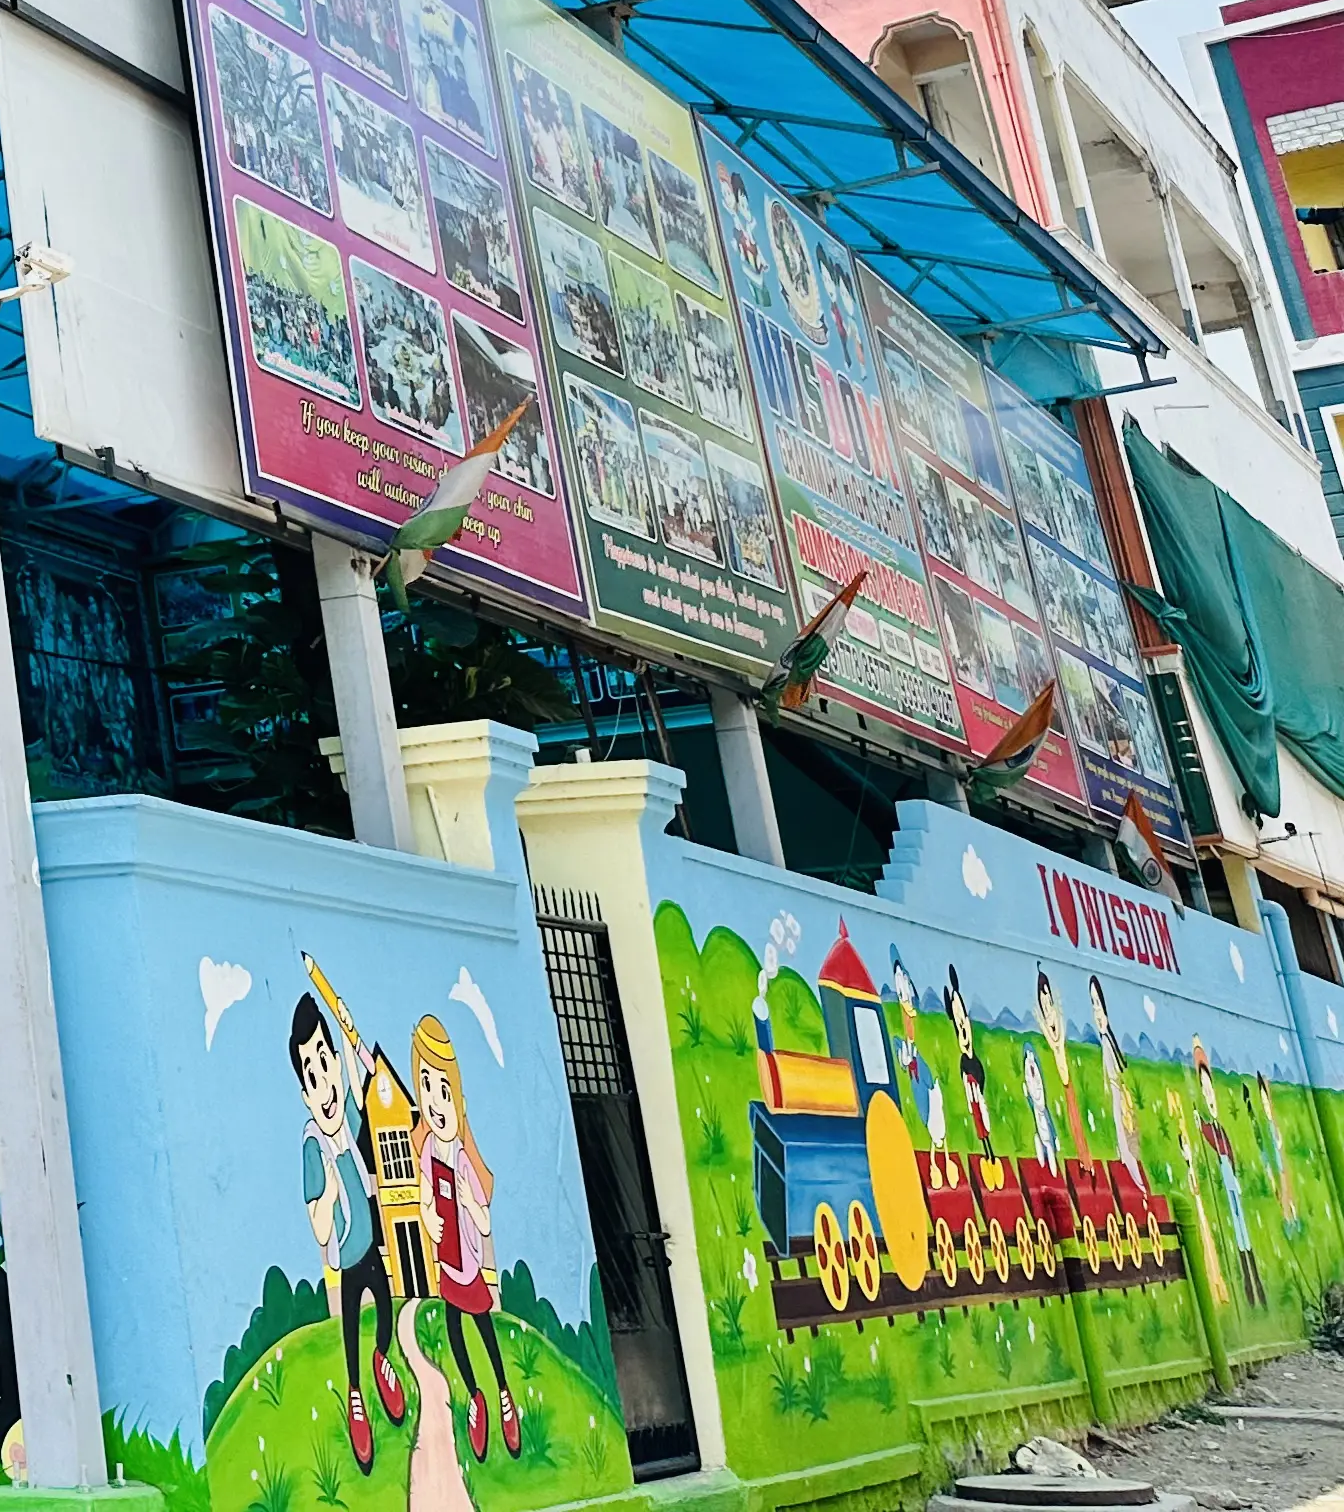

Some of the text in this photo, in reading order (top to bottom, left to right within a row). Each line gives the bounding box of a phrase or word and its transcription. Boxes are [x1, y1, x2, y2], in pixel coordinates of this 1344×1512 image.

[740, 297, 903, 498] WISDOM
[299, 400, 316, 434] If
[316, 416, 342, 439] you
[343, 417, 370, 457] keep
[372, 441, 401, 464] your
[403, 451, 437, 480] vision
[513, 496, 535, 523] chin
[356, 467, 502, 549] will up
[1036, 862, 1182, 976] I WISDOM
